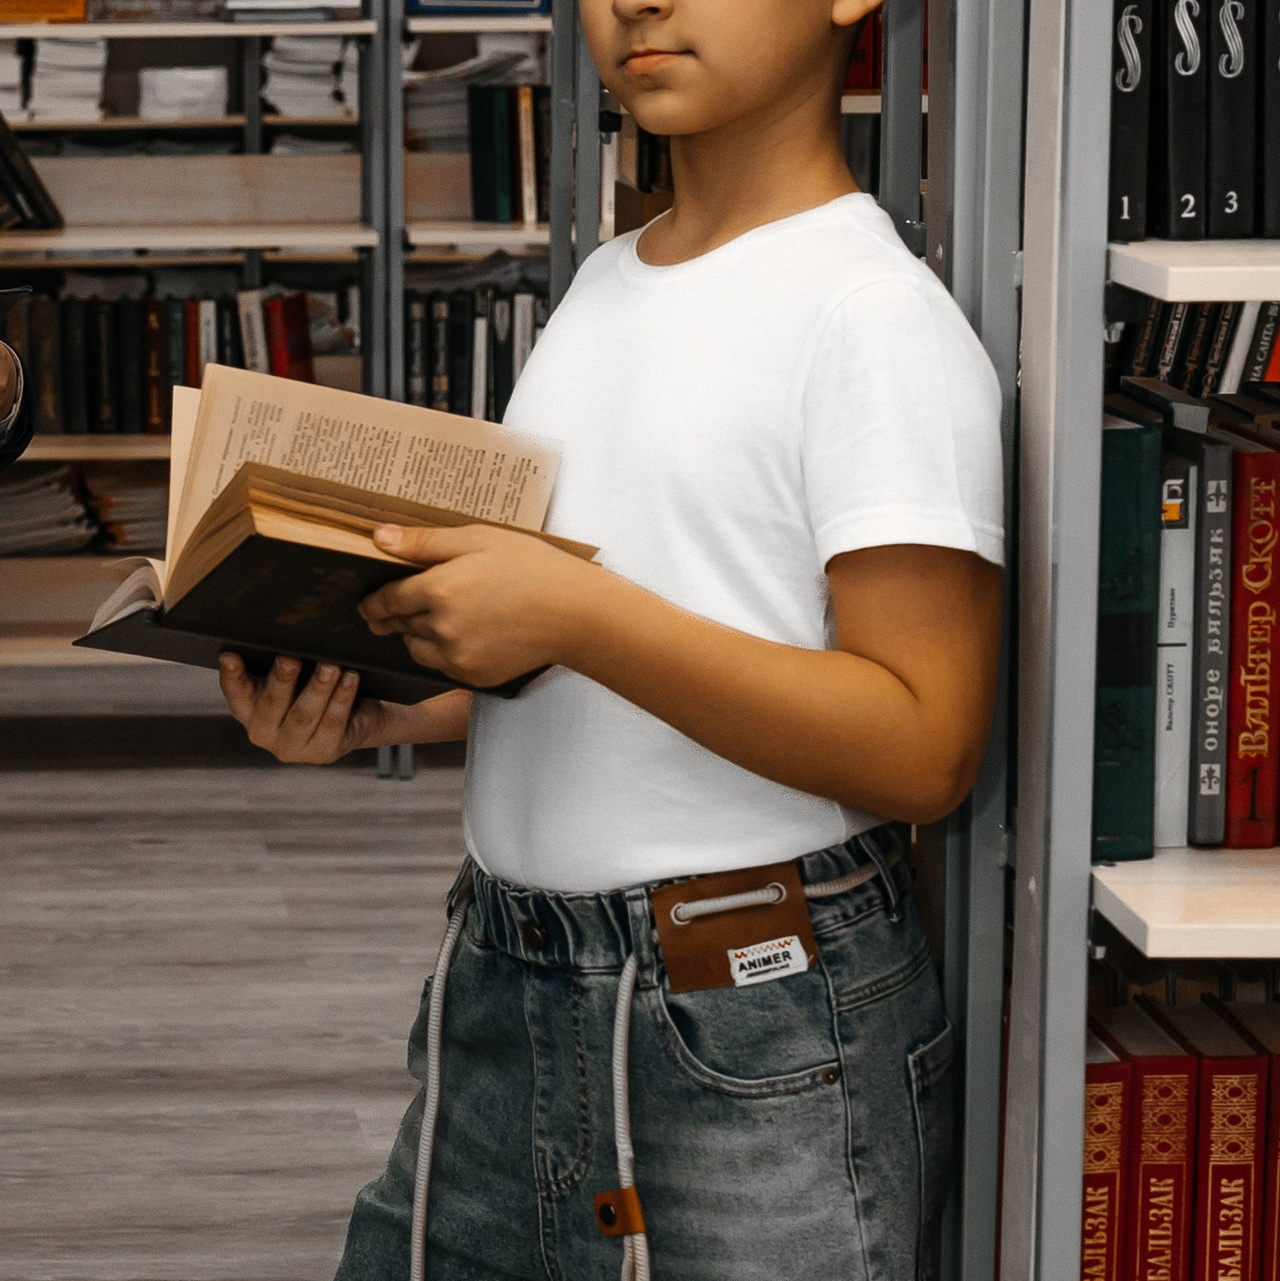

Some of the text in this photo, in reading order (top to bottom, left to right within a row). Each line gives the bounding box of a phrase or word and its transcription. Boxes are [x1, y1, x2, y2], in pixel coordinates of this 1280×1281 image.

[1121, 195, 1131, 220] 1
[1181, 194, 1197, 218] 2
[1224, 190, 1239, 214] 3
[1166, 663, 1175, 696] СКОТТ
[738, 950, 793, 973] ANIMER
